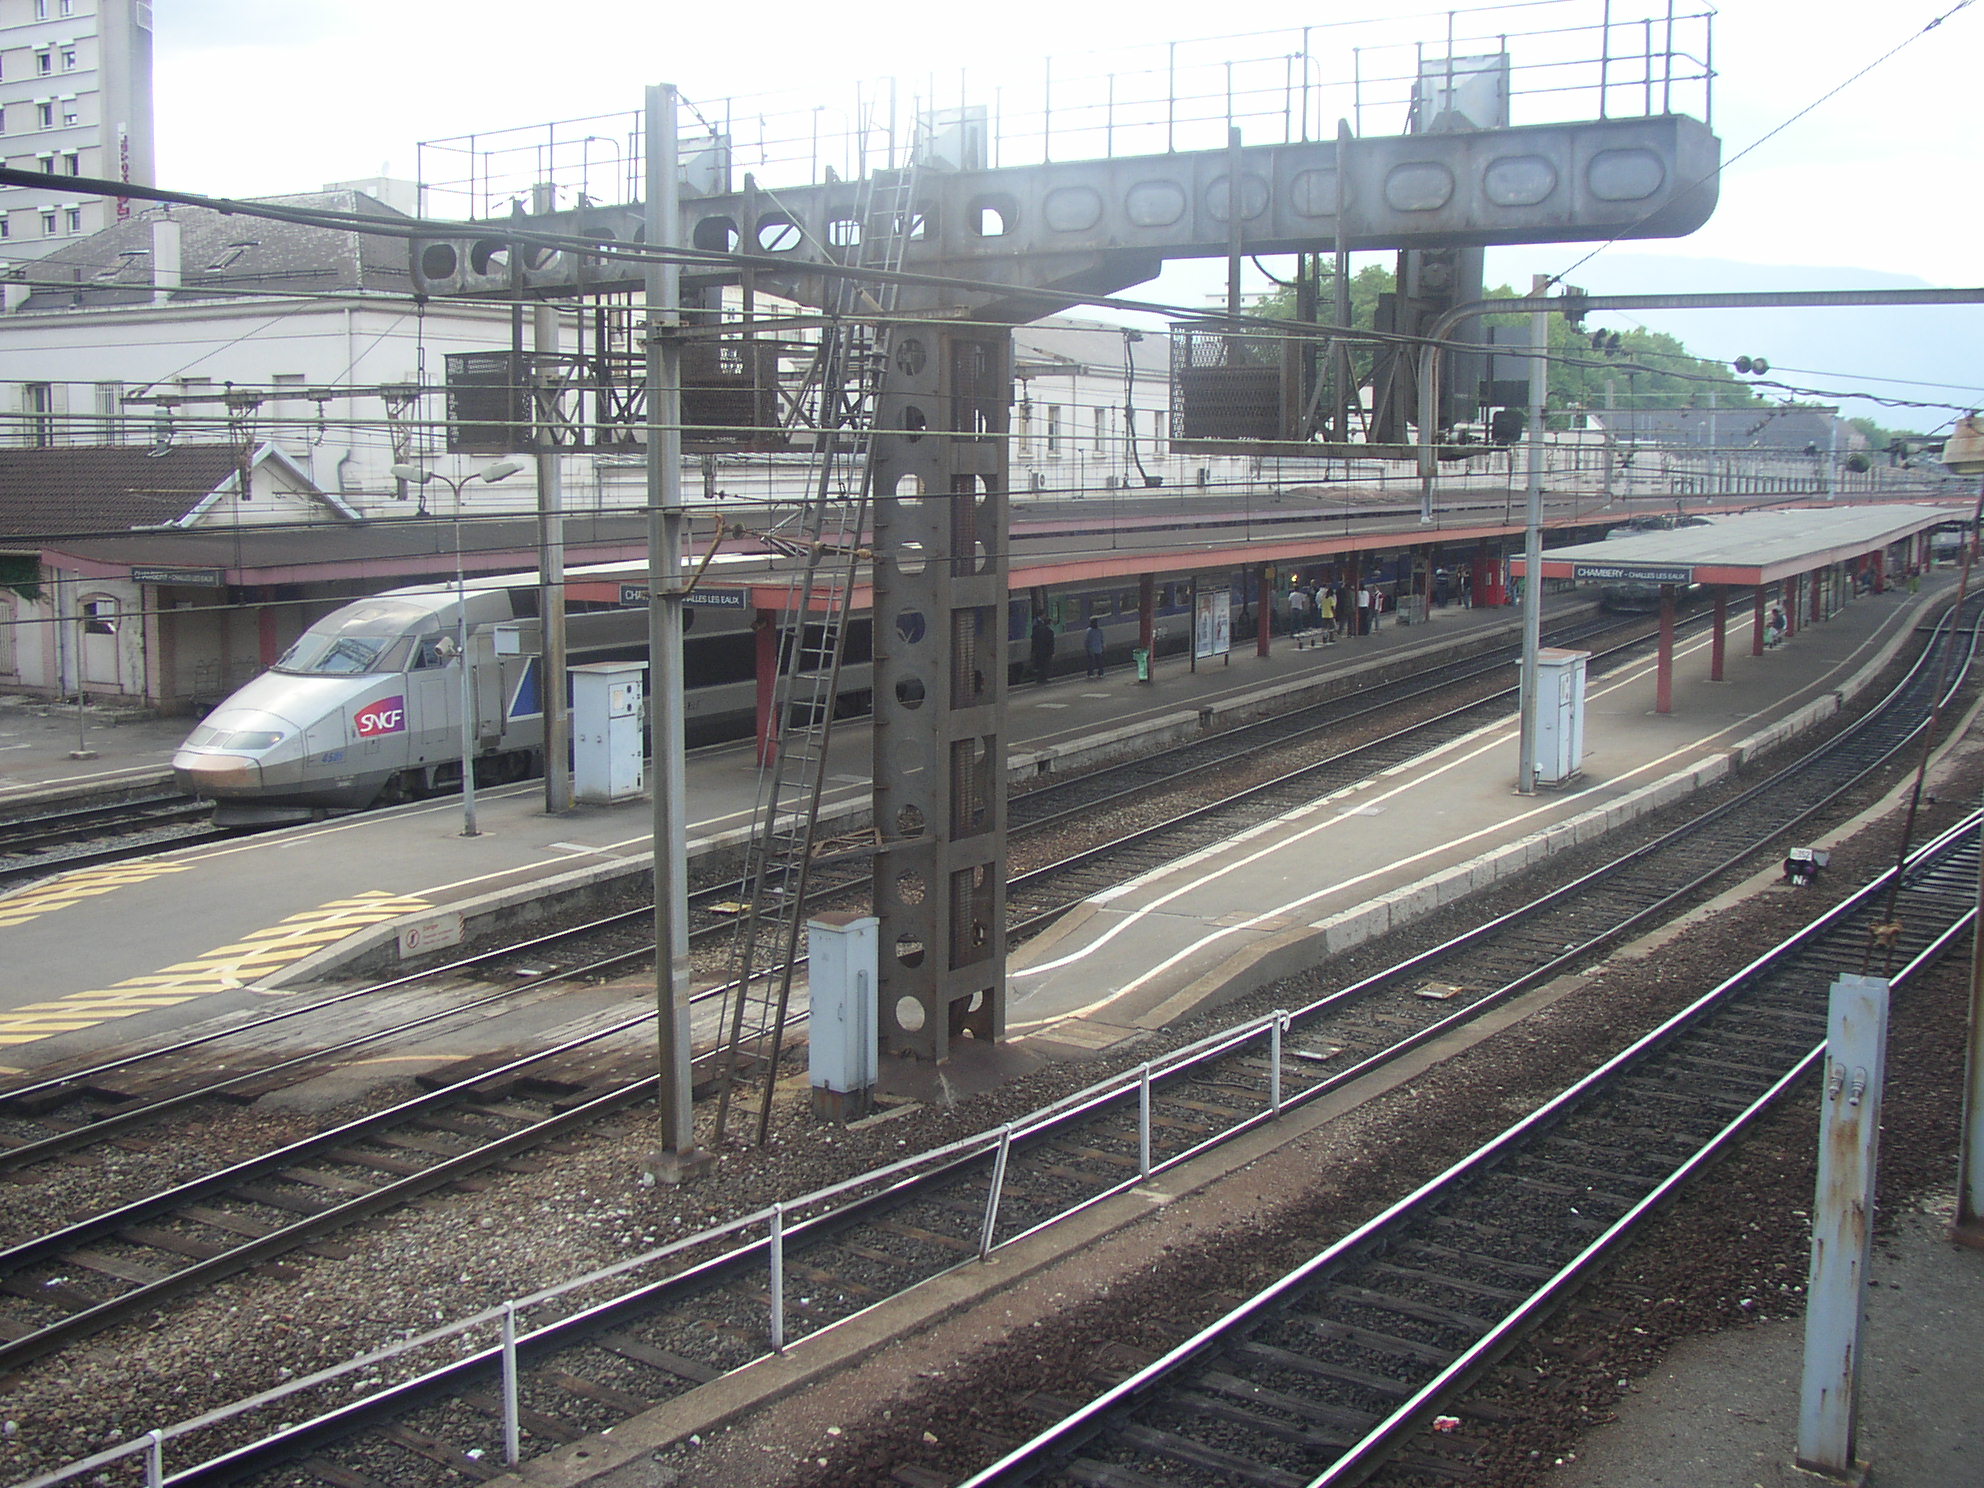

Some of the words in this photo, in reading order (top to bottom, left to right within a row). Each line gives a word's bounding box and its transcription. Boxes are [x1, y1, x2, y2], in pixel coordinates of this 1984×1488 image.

[1577, 568, 1624, 578] CHAMBERY
[721, 596, 739, 605] EAUX
[360, 709, 402, 732] SNCF
